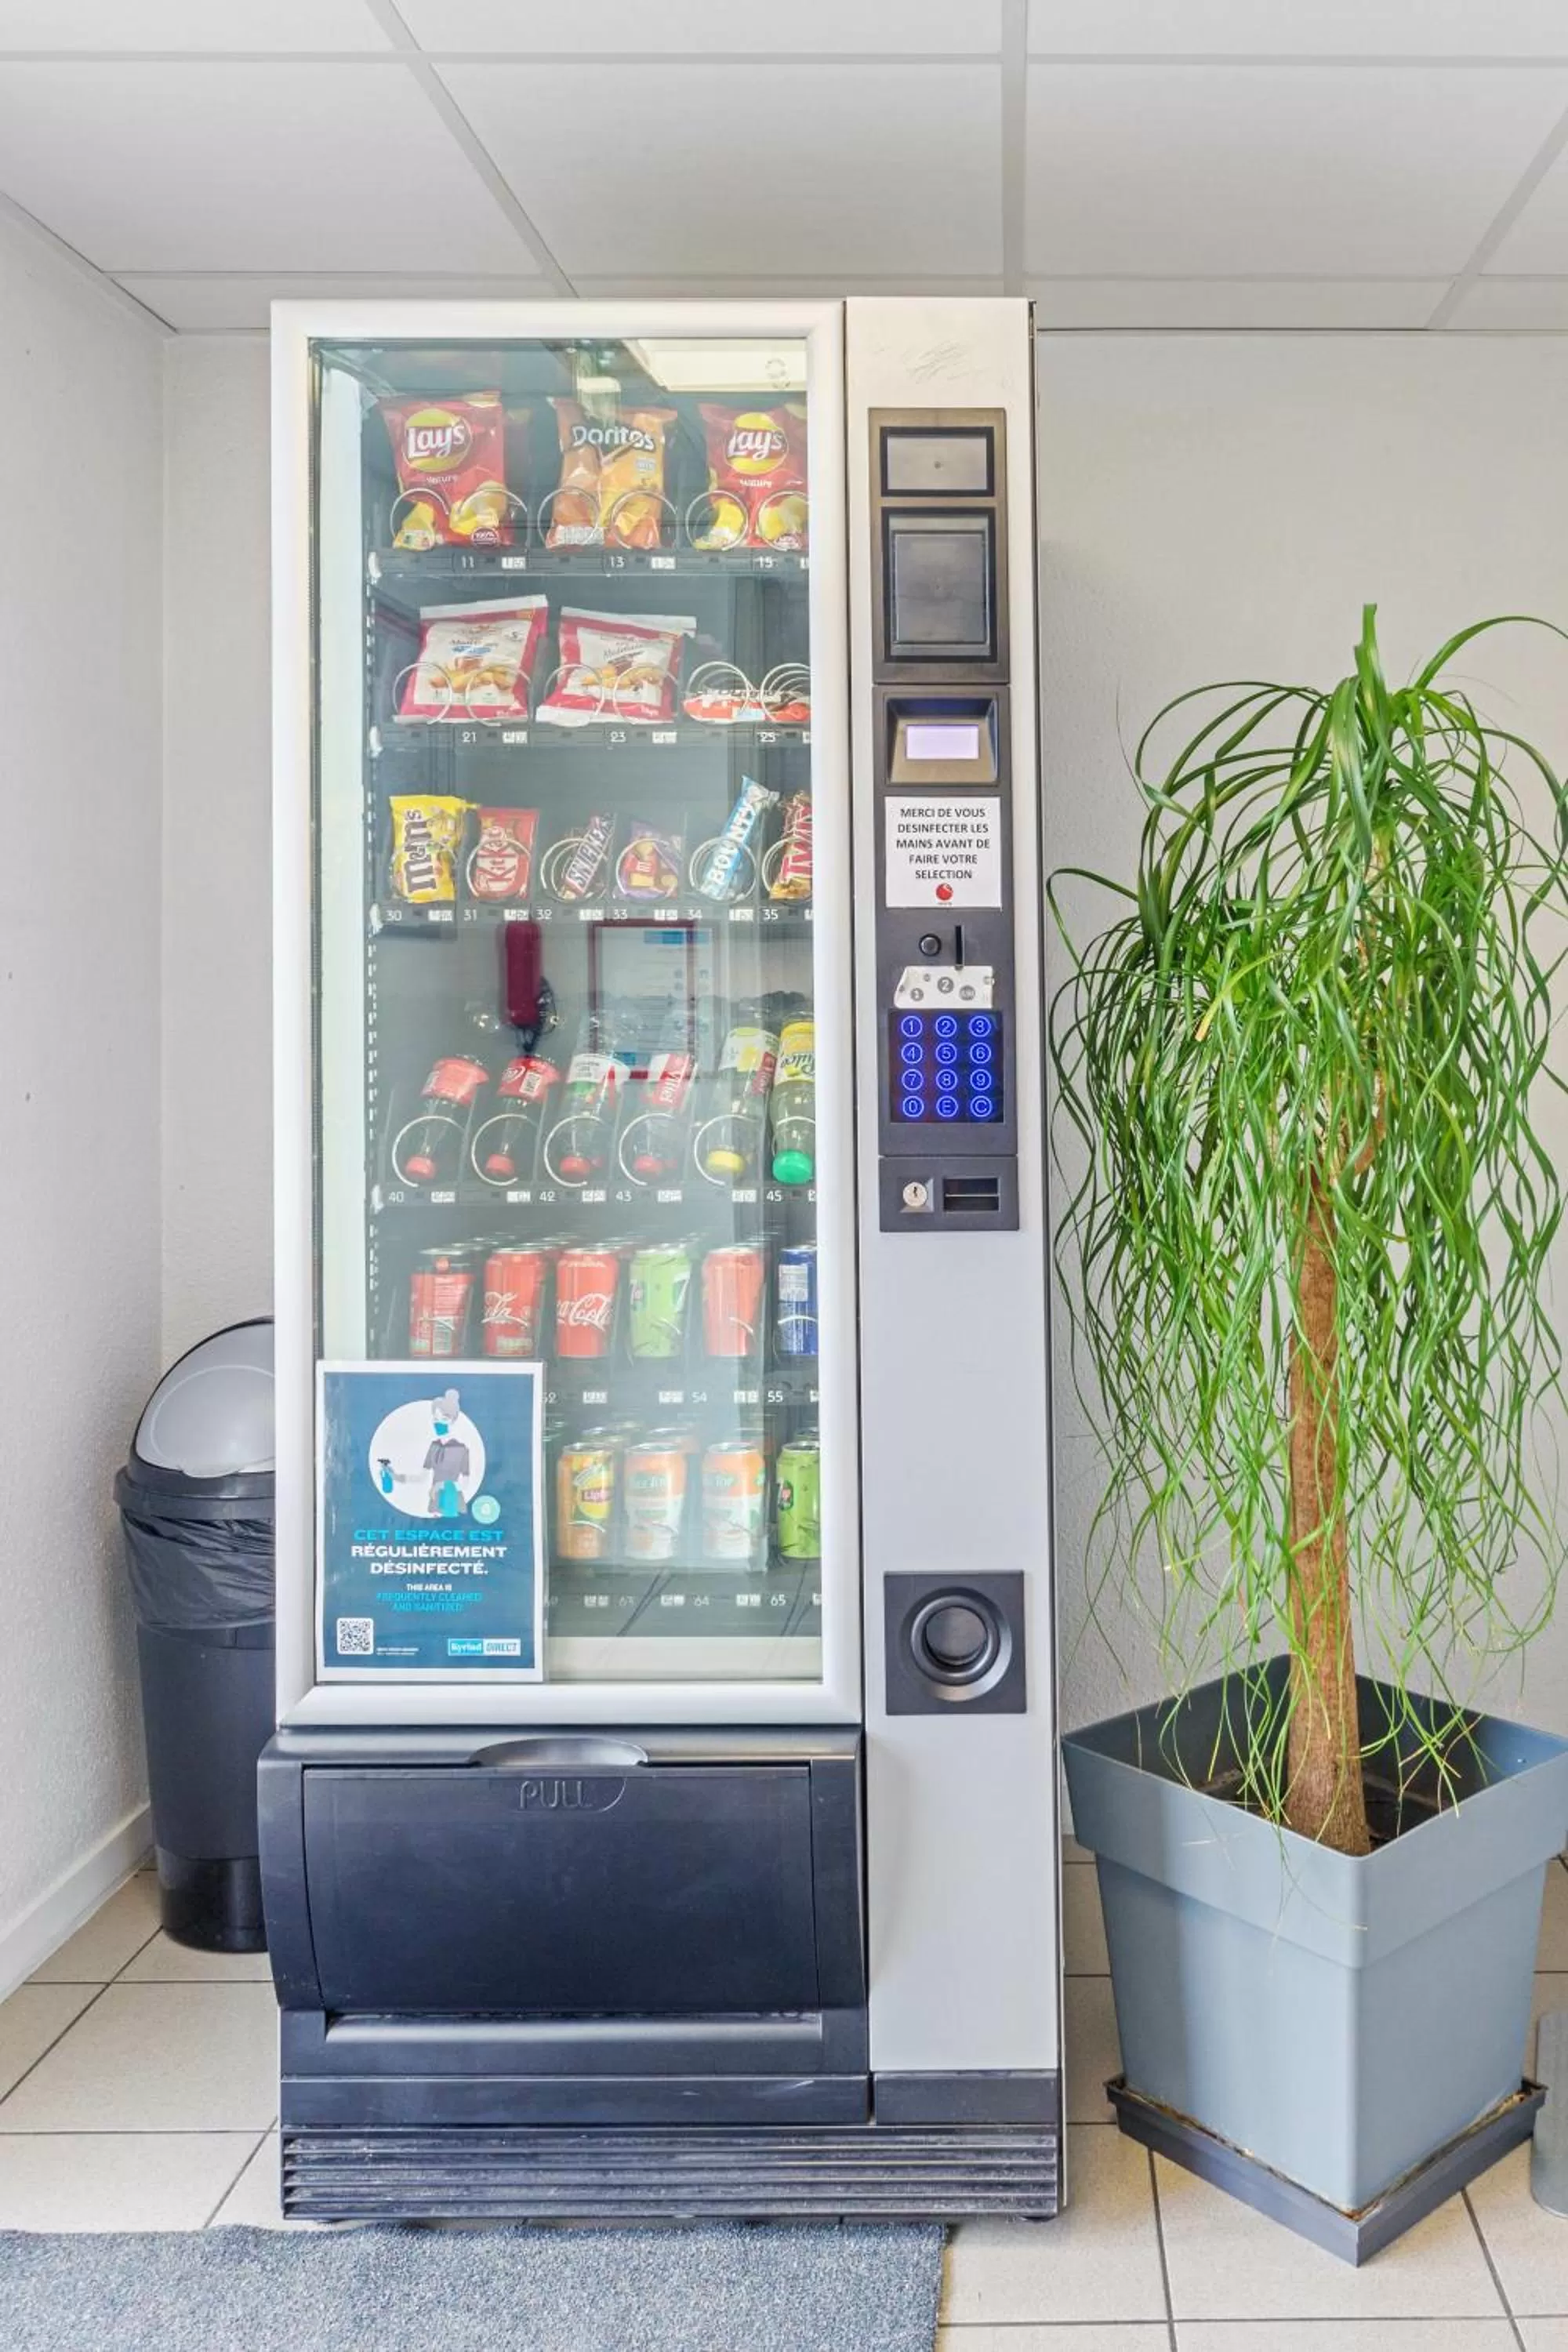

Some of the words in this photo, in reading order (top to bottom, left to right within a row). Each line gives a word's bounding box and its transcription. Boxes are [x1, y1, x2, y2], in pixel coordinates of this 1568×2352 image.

[407, 424, 465, 458] Lay's
[572, 426, 655, 450] Doritos
[728, 430, 783, 460] Lay's
[462, 556, 474, 568] 11
[610, 556, 625, 568] 13
[462, 731, 477, 742] 21
[610, 731, 626, 742] 23
[900, 808, 935, 818] MERCI
[938, 808, 952, 818] DE
[955, 808, 985, 818] VOUS
[898, 824, 968, 833] DESINFECTER
[971, 824, 989, 833] LES
[896, 840, 934, 849] MAINS
[935, 840, 974, 849] AVANT
[976, 840, 990, 849] DE
[909, 855, 940, 864] FAIRE
[942, 855, 978, 864] VOTRE
[915, 869, 973, 879] SELECTION
[386, 910, 402, 921] 30
[463, 910, 477, 921] 31
[535, 909, 553, 920] 32
[763, 909, 779, 920] 35
[909, 1021, 914, 1033] 1
[942, 1020, 950, 1033] 2
[975, 1020, 985, 1033] 3
[907, 1047, 915, 1059] 4
[942, 1047, 951, 1059] 5
[976, 1047, 985, 1059] 6
[908, 1073, 916, 1086] 7
[942, 1073, 952, 1086] 8
[976, 1073, 985, 1086] 9
[909, 1100, 918, 1112] 0
[943, 1100, 952, 1112] E
[975, 1100, 987, 1112] C
[539, 1192, 556, 1202] 42
[615, 1192, 632, 1202] 43
[766, 1191, 782, 1201] 45
[693, 1392, 707, 1403] 54
[768, 1392, 783, 1403] 55
[354, 1530, 389, 1541] CET
[394, 1530, 464, 1541] ESPACE
[469, 1530, 504, 1541] EST
[351, 1542, 508, 1558] RÉGULIÈREMENT
[370, 1559, 488, 1574] DÉSINFECTÉ.
[376, 1592, 437, 1601] FREQUENTLY
[771, 1595, 786, 1606] 65
[520, 1780, 593, 1809] PULL
